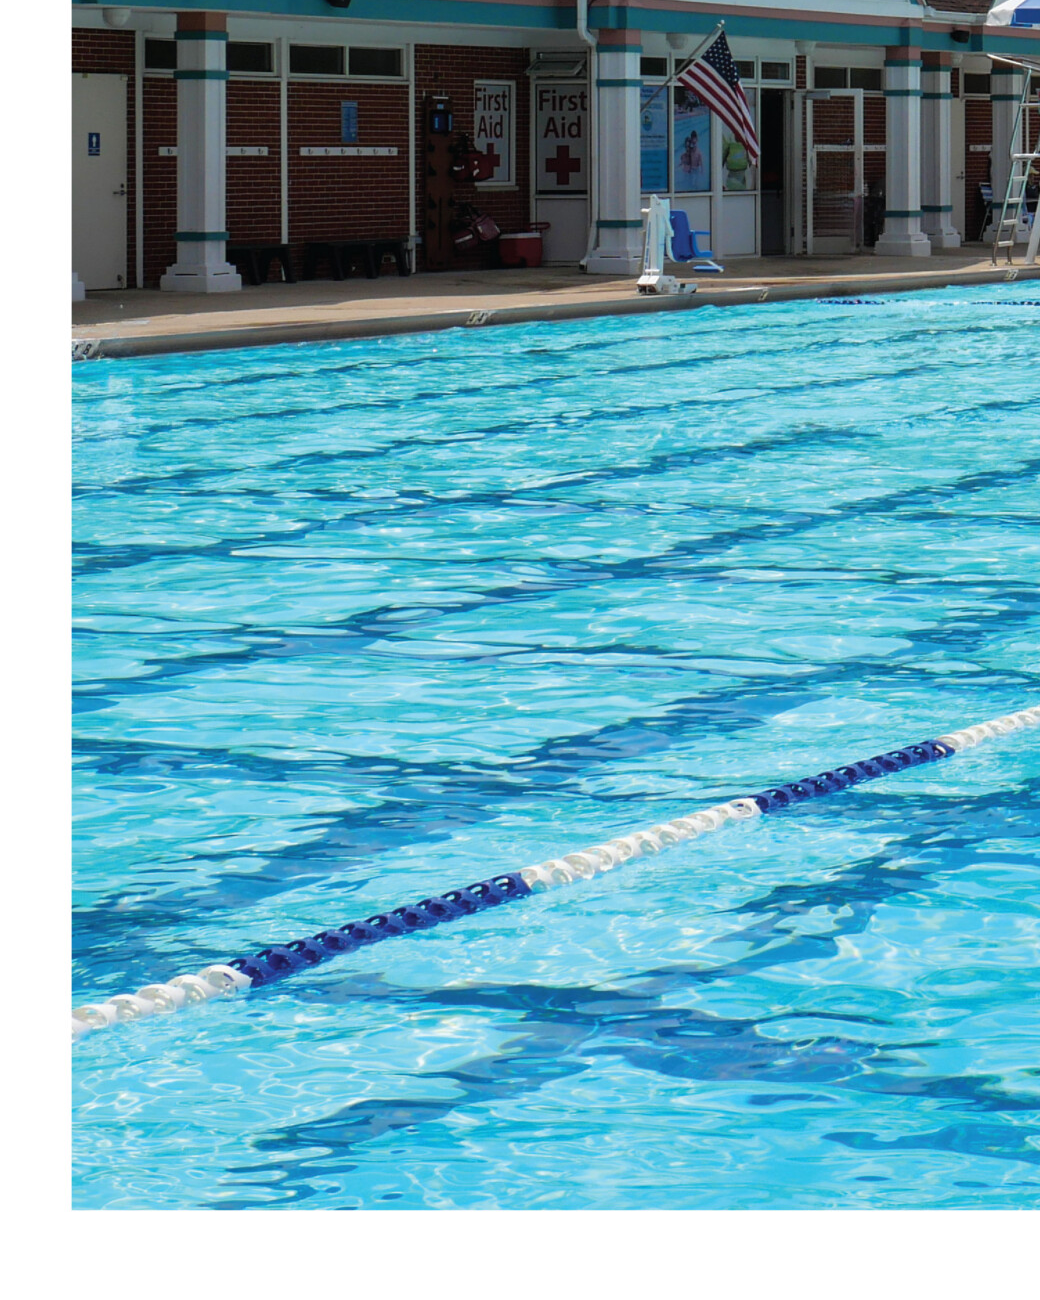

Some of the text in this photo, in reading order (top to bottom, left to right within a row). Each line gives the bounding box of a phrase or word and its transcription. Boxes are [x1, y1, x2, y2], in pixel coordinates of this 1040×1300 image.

[475, 87, 507, 112] First
[539, 89, 587, 112] First
[477, 114, 503, 138] Aid
[543, 115, 581, 138] Aid
